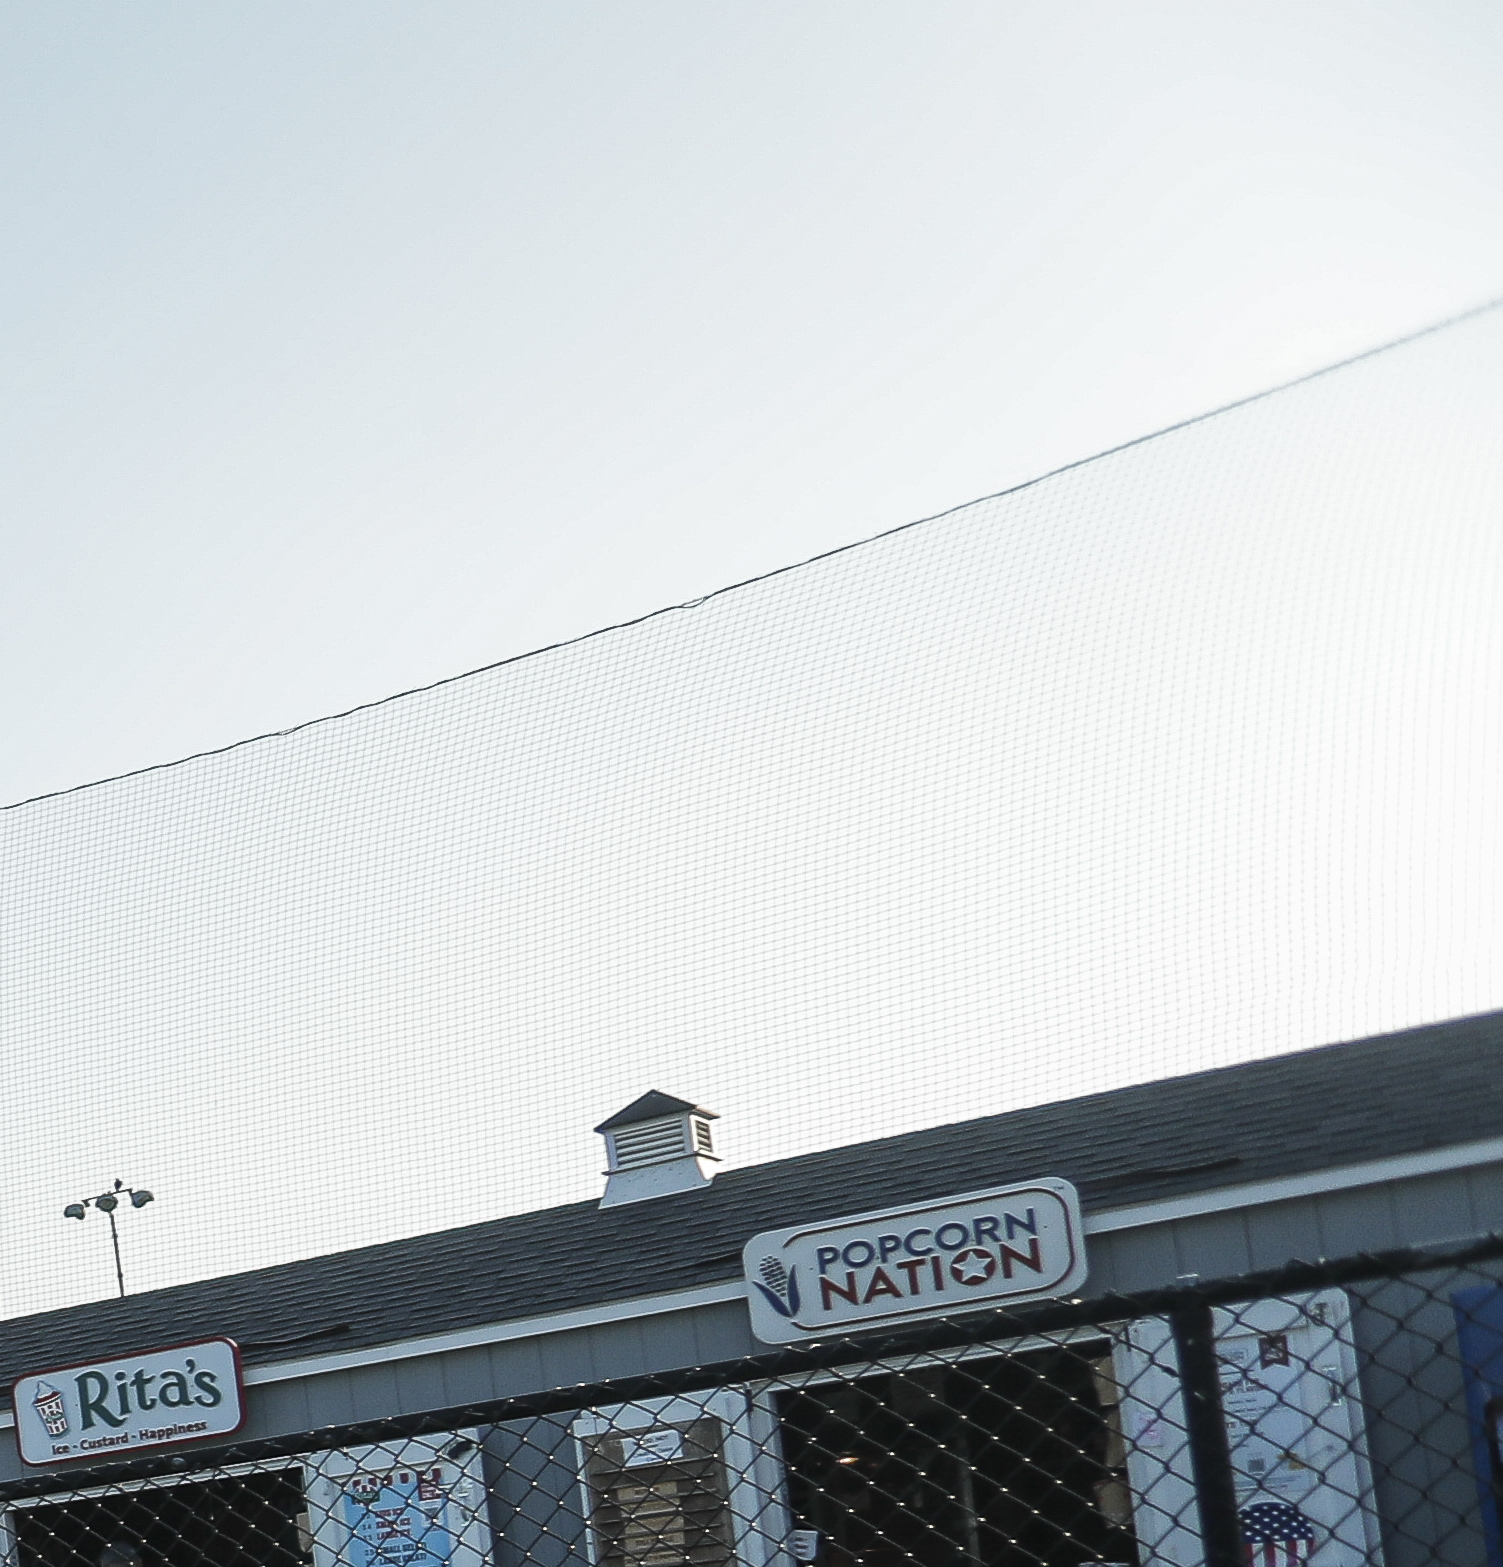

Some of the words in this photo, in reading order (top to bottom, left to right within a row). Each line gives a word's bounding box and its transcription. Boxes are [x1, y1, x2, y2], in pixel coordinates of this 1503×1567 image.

[816, 1207, 1038, 1275] POPCORN
[818, 1236, 1042, 1310] NATION
[74, 1359, 222, 1431] Rita's
[52, 1443, 70, 1455] Ice
[80, 1432, 128, 1451] Custard
[139, 1421, 207, 1441] Happiness
